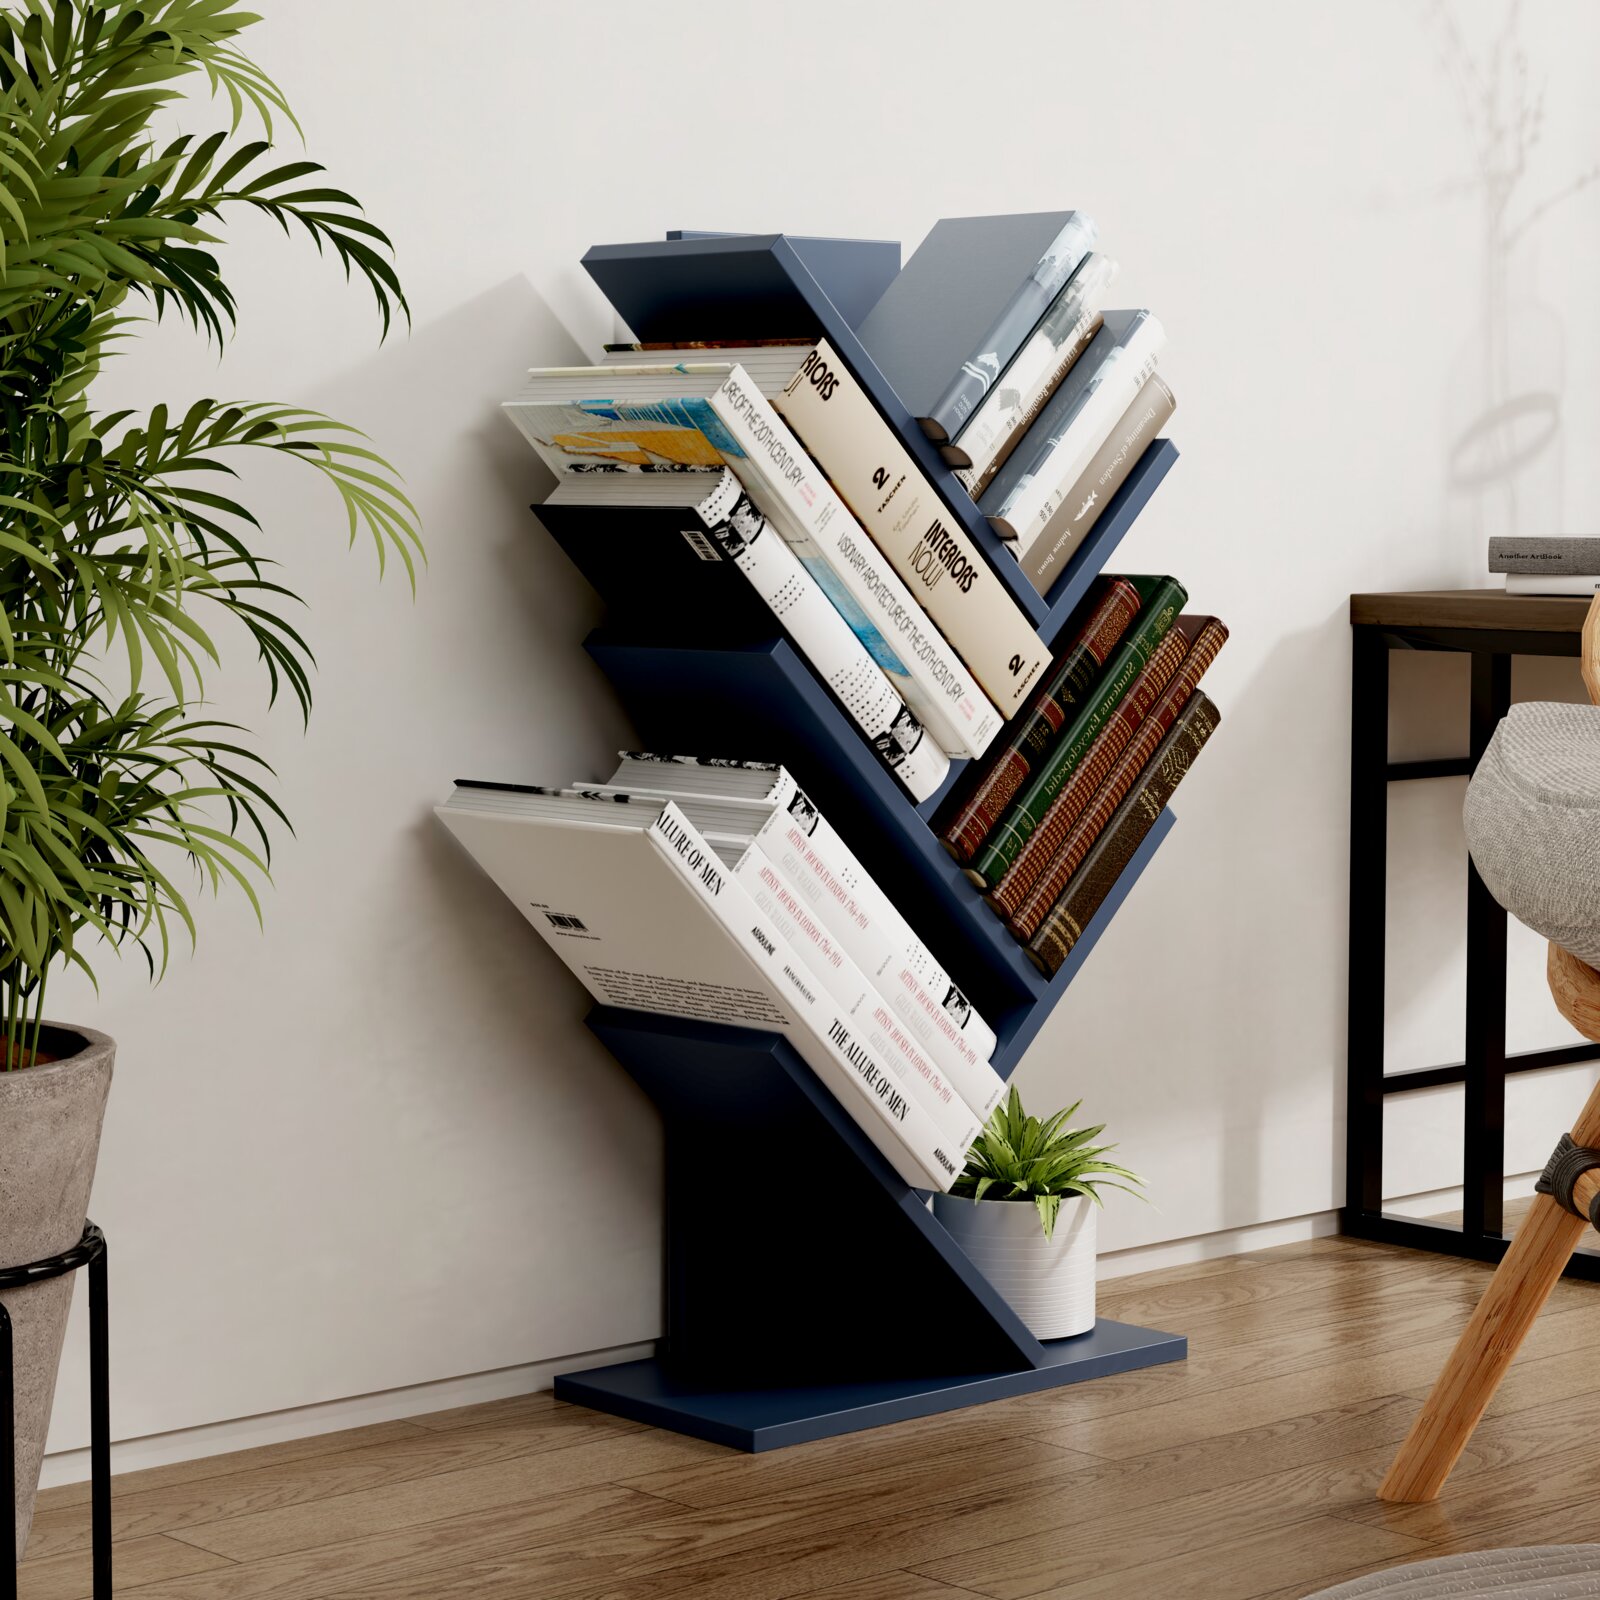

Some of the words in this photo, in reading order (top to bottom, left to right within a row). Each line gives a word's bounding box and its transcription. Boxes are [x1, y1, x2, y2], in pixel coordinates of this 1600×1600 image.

[1021, 387, 1049, 425] Revolution
[1126, 407, 1156, 447] Dreaming
[872, 466, 890, 490] 2
[1099, 453, 1122, 485] Sweden
[877, 475, 906, 513] TASCHEN
[1052, 528, 1072, 552] Andrew
[908, 540, 944, 591] NOW!
[924, 519, 978, 594] INTERIORS
[1037, 553, 1055, 575] Brown
[1008, 653, 1025, 676] 2
[1013, 661, 1040, 699] TASCHEN
[699, 863, 724, 898] MEN
[825, 877, 848, 904] LONDON
[751, 926, 775, 956] ASSOULINE
[799, 916, 821, 943] LONDON
[935, 1015, 957, 1041] LONDON
[828, 1018, 849, 1050] THE
[844, 1041, 880, 1087] ALLURE
[886, 1090, 910, 1123] MEN
[909, 1053, 932, 1079] LONDON
[933, 1148, 955, 1176] ASSOULINE
